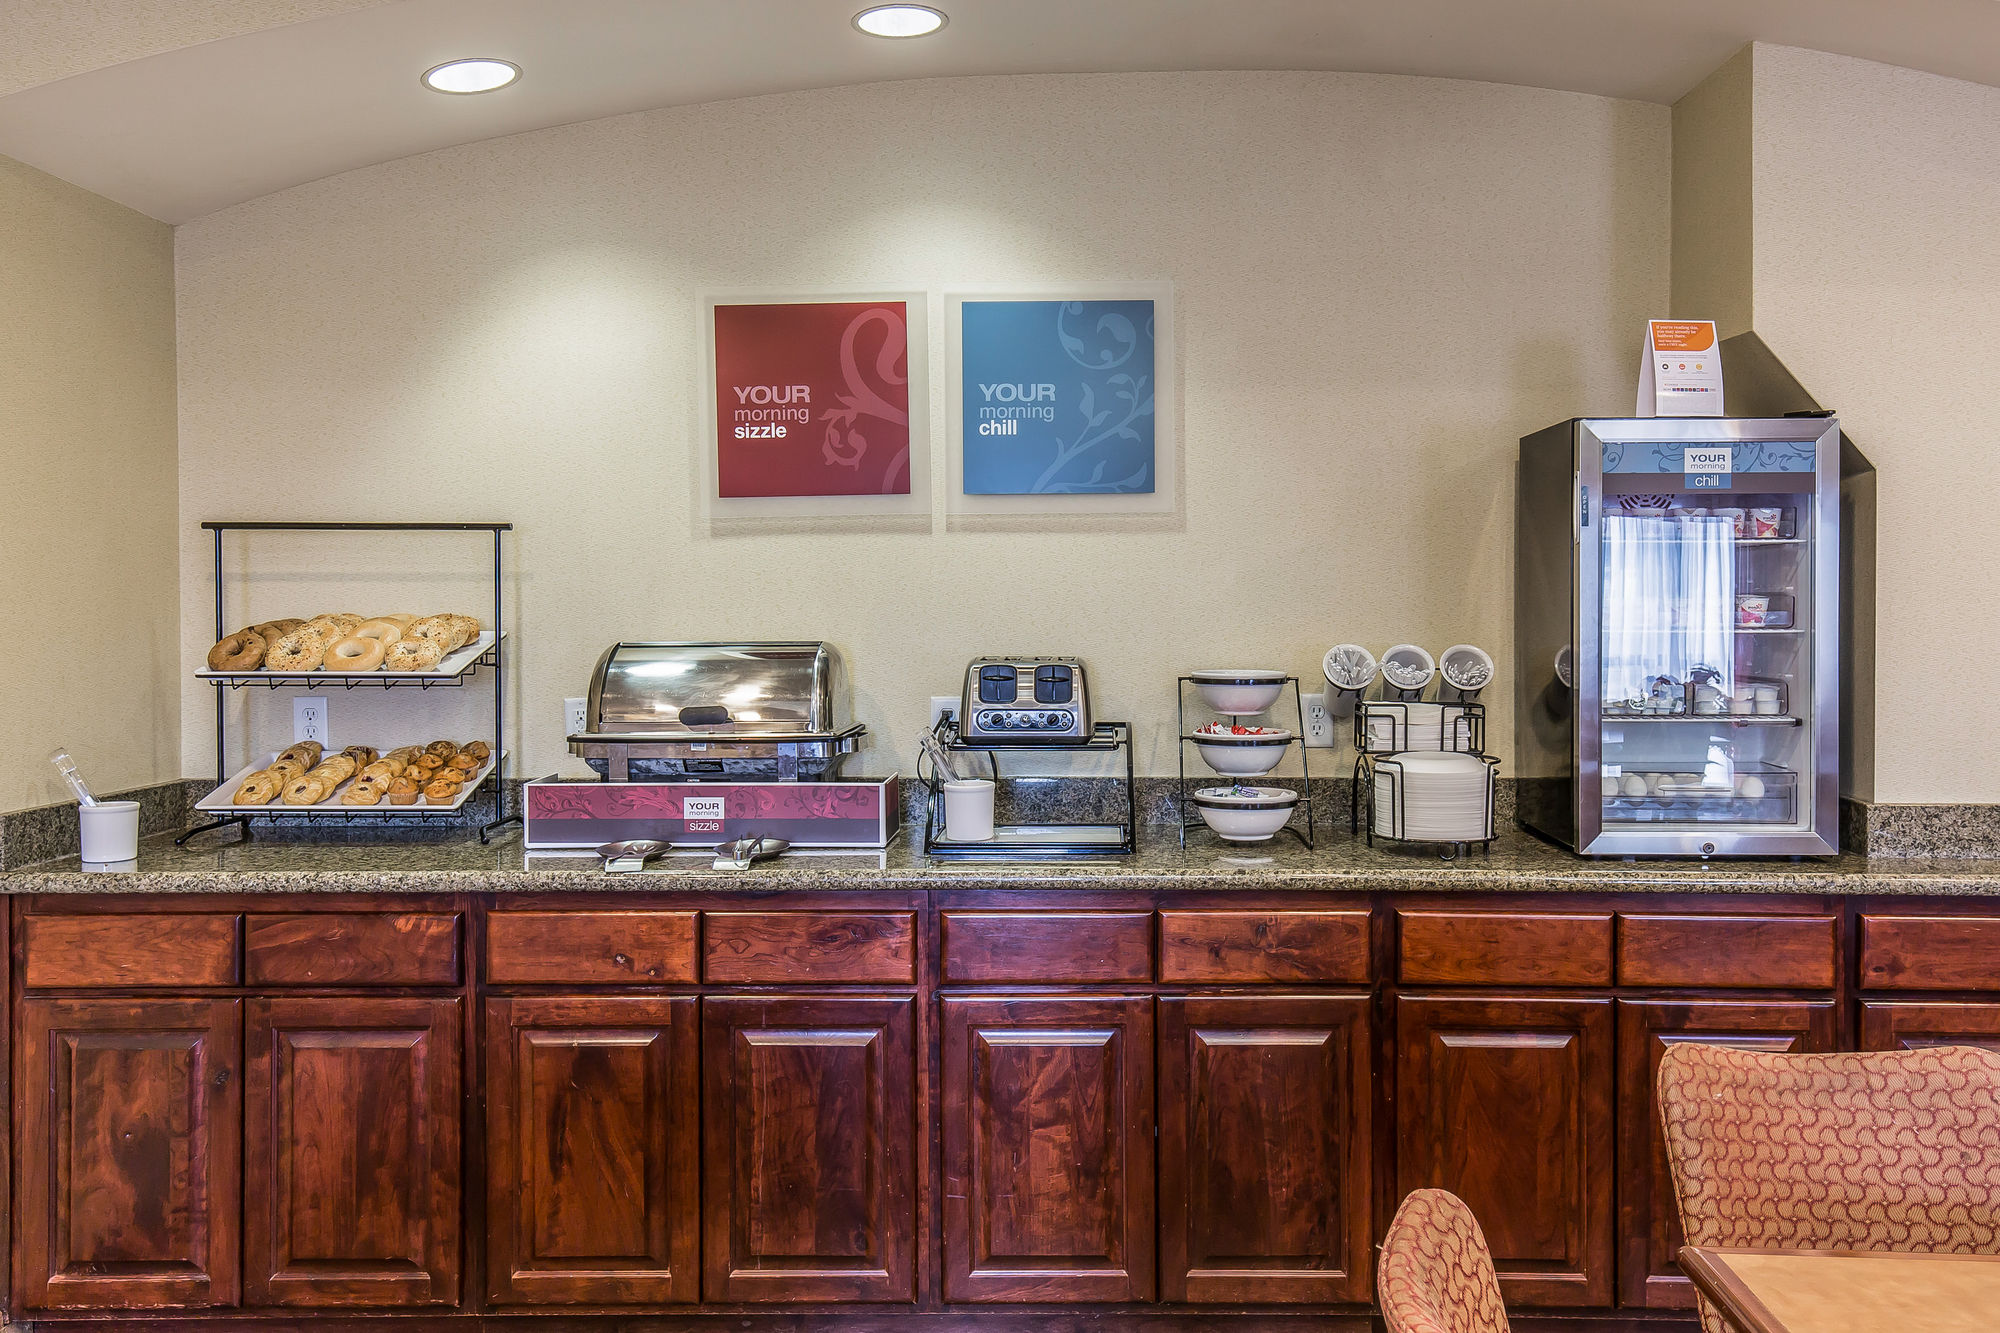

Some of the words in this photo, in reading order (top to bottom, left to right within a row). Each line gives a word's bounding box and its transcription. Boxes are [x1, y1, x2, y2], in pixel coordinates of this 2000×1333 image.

[733, 385, 811, 404] YOUR
[978, 383, 1056, 401] YOUR
[734, 405, 809, 424] morning
[979, 403, 1054, 422] morning
[734, 422, 787, 439] sizzle
[979, 419, 1017, 436] chill
[1690, 454, 1726, 462] YOUR
[1690, 463, 1726, 471] morning
[1695, 474, 1719, 487] chill
[688, 802, 719, 810] YOUR
[689, 820, 719, 831] sizzle
